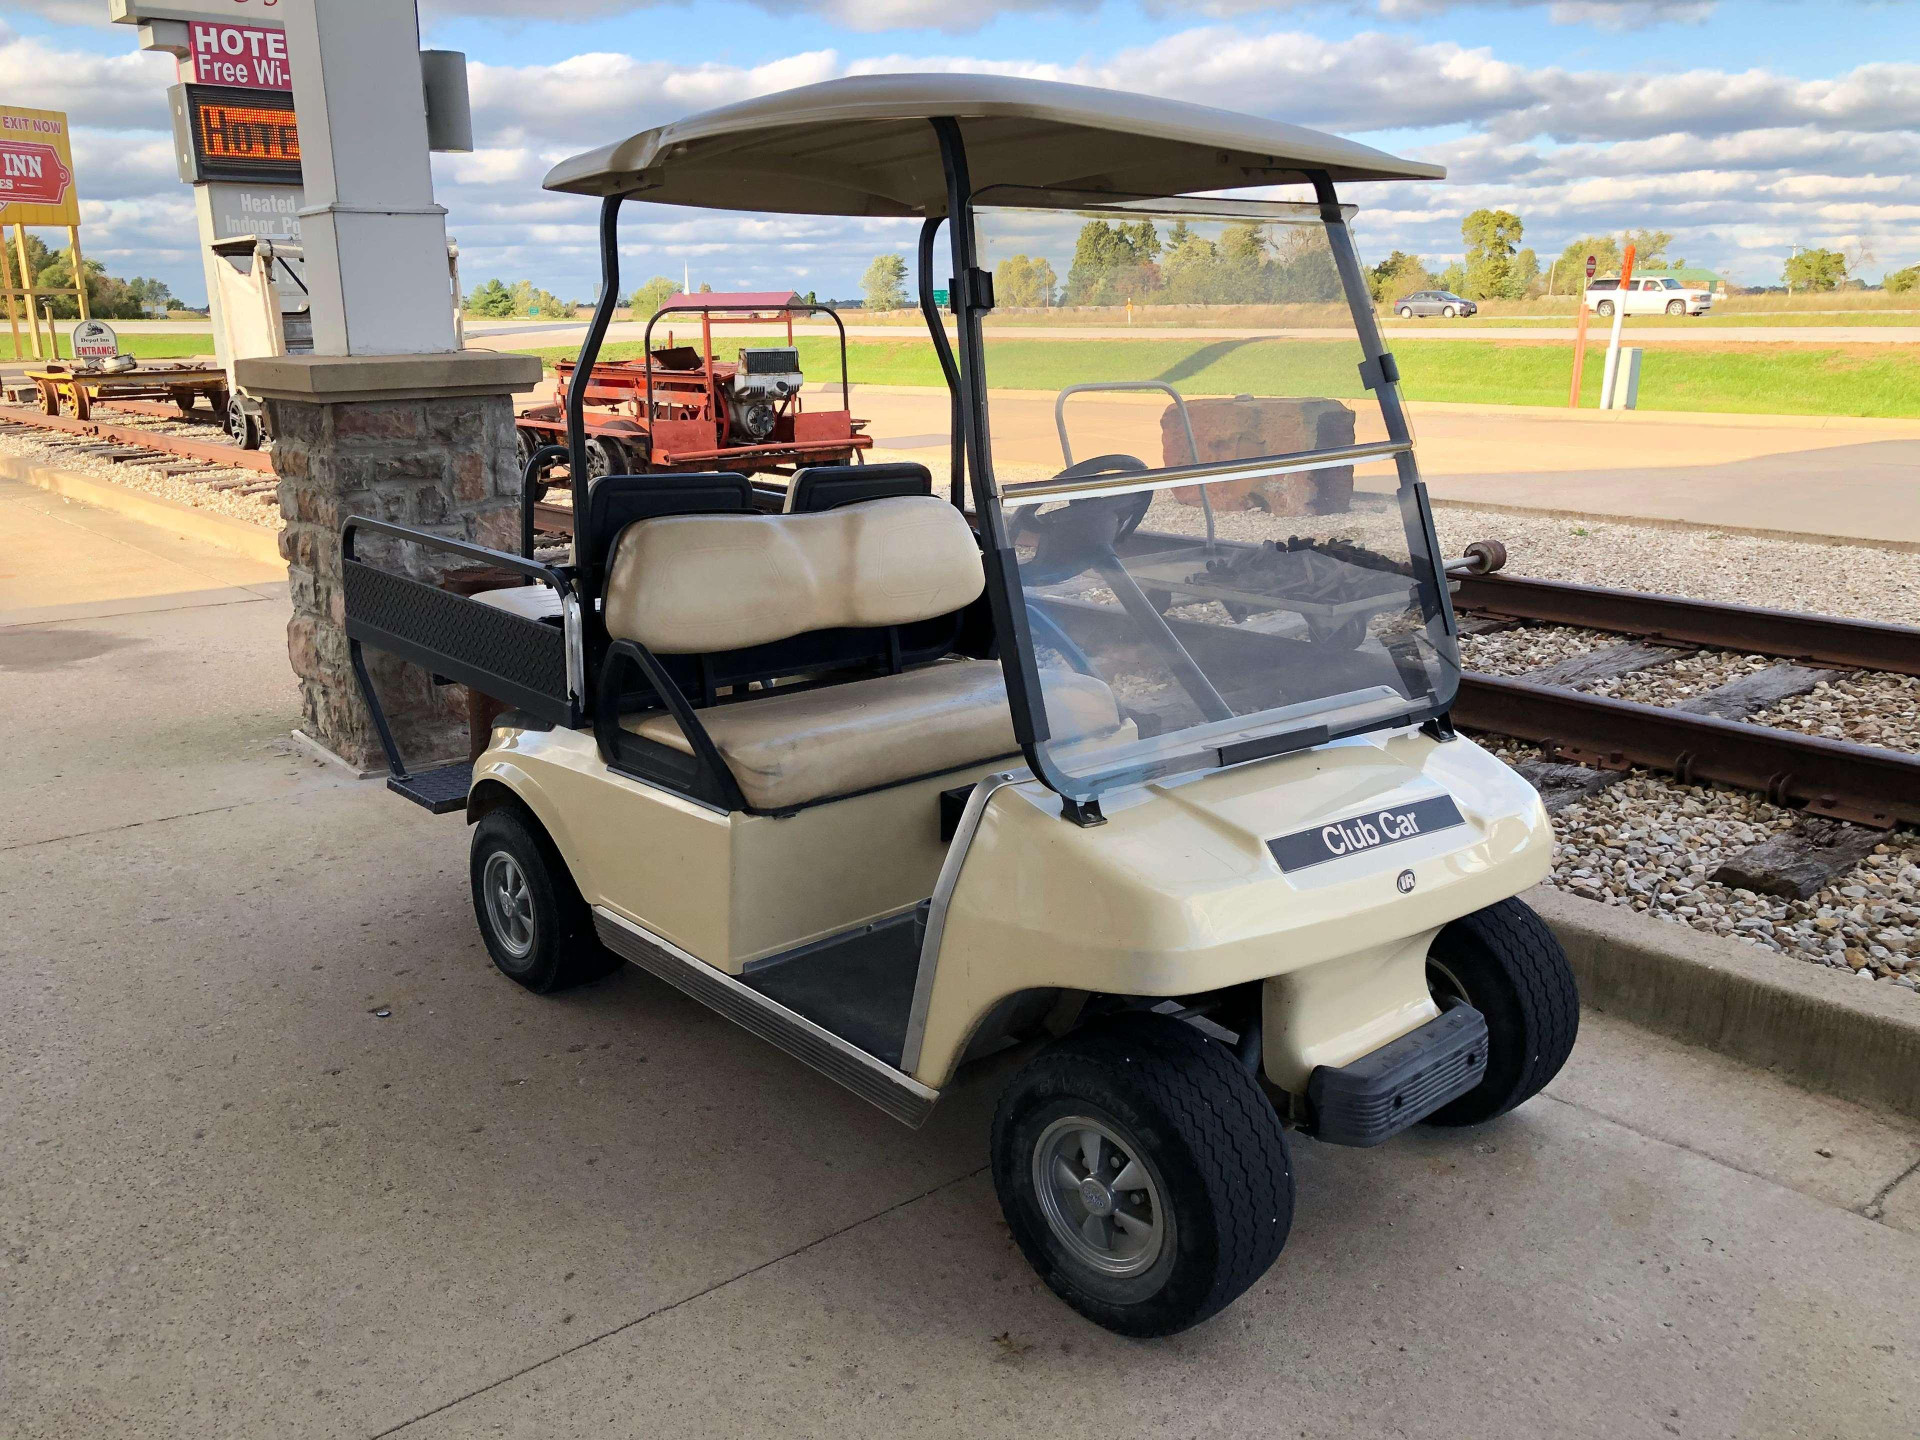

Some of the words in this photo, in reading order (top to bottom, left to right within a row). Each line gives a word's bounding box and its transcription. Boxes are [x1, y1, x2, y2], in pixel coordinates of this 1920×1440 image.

[198, 54, 248, 83] Free
[2, 116, 29, 130] EXIT
[33, 119, 61, 134] NOW
[3, 153, 42, 178] INN
[241, 193, 296, 214] Heated
[225, 214, 275, 234] Indoor
[77, 346, 116, 355] ENTRANCE
[1322, 818, 1380, 855] Club
[1378, 811, 1420, 840] Car
